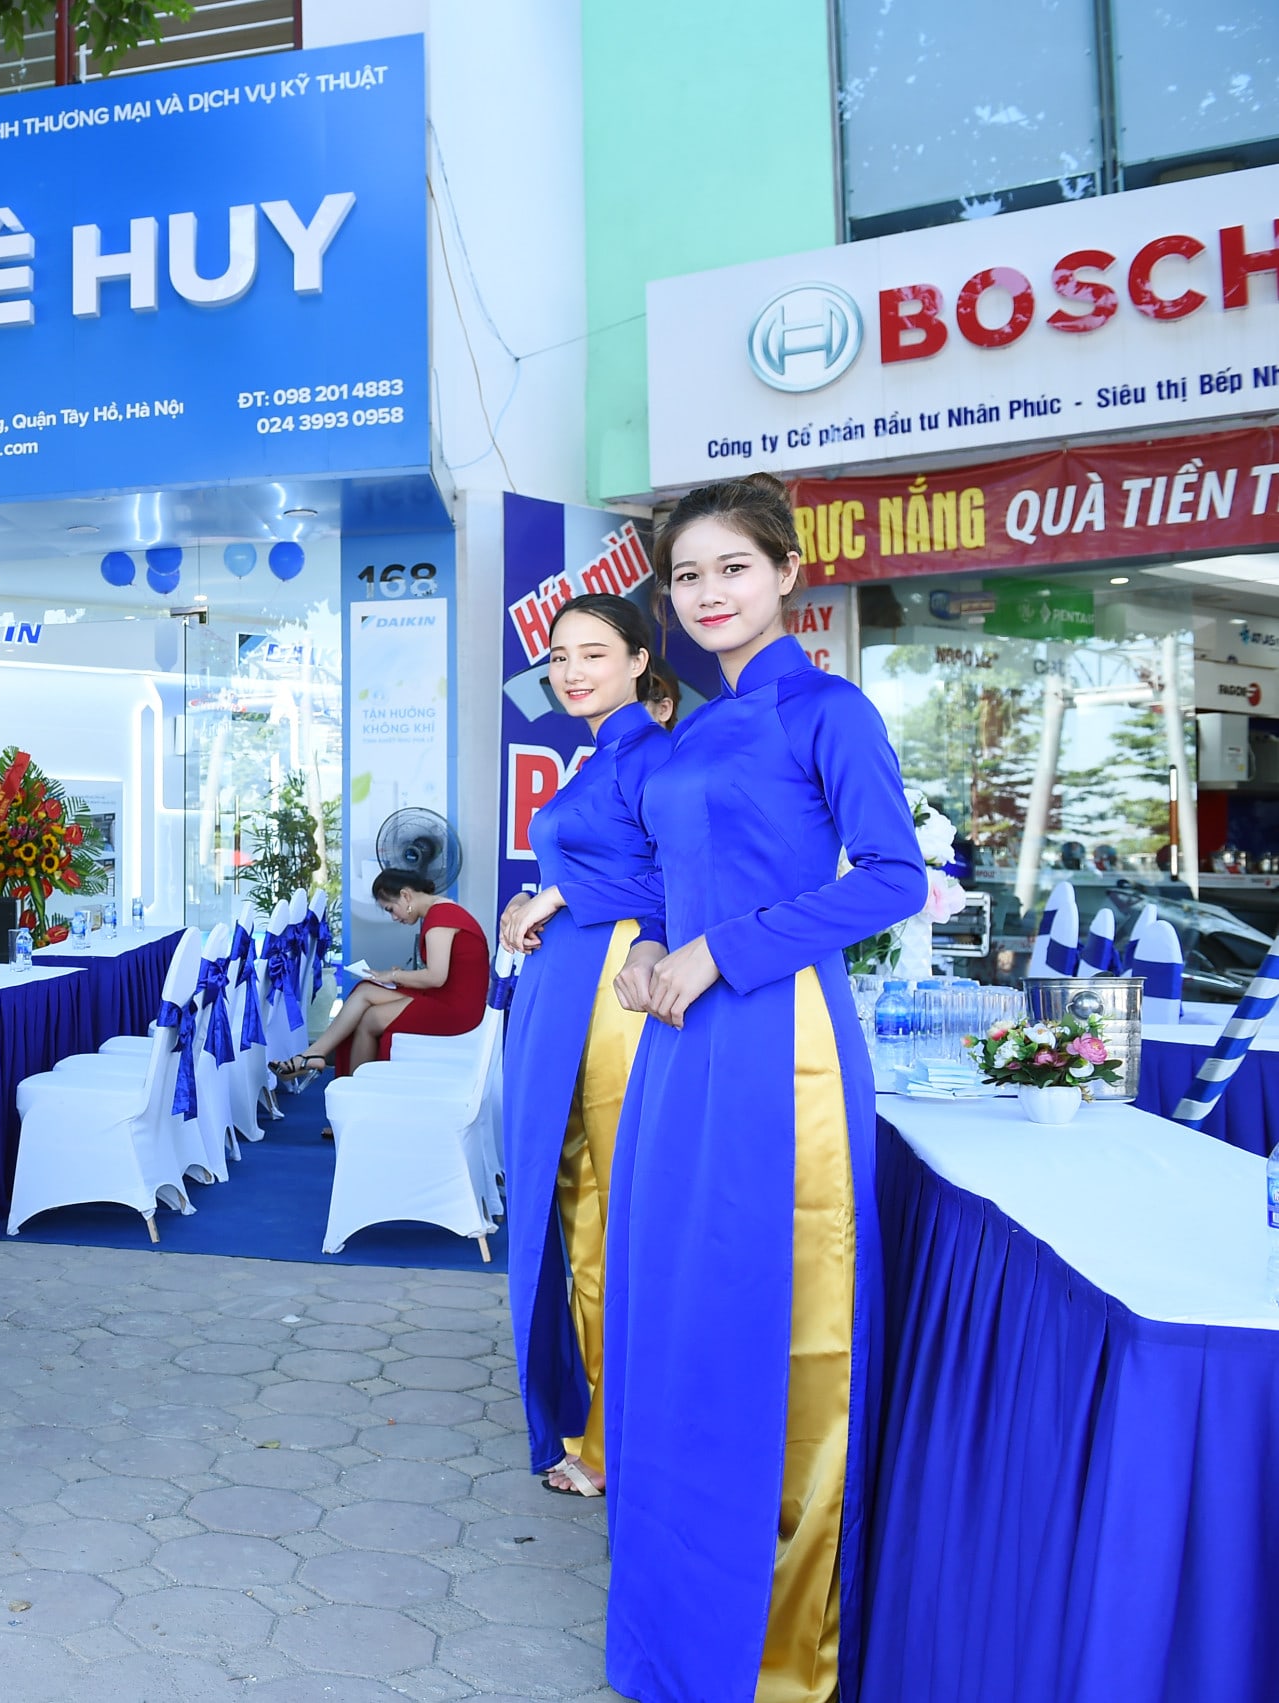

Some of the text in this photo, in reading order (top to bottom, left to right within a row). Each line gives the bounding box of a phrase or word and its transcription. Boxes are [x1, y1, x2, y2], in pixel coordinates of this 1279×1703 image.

[22, 107, 109, 135] THƯƠNG
[113, 101, 151, 122] MẠI
[156, 93, 184, 115] VÀ
[188, 87, 240, 113] DỊCH
[244, 82, 277, 104] VỤ
[280, 72, 310, 98] KỸ
[316, 65, 389, 91] THUẬT
[72, 192, 357, 318] HUY
[878, 217, 1279, 364] BOSCH
[12, 411, 57, 431] Quận
[60, 408, 90, 428] Tây
[94, 402, 124, 422] Hồ,
[125, 401, 151, 418] Hà
[154, 398, 185, 420] Nội
[237, 378, 404, 409] ĐT: 098 201 4883
[256, 406, 404, 434] 024 3993 0958
[707, 437, 753, 458] Công
[761, 433, 779, 453] ty
[787, 421, 814, 449] Cổ
[819, 416, 866, 447] phần
[873, 409, 913, 437] Đầu
[919, 411, 941, 432] tư
[947, 402, 1001, 428] Nhân
[1009, 394, 1062, 419] Phúc
[1097, 383, 1147, 408] Siêu
[1157, 377, 1188, 402] thị
[1200, 366, 1243, 395] Bếp
[879, 474, 986, 556] NẮNG
[1005, 472, 1106, 545] QUÀ
[1121, 457, 1238, 529] TIỀN
[1250, 463, 1279, 517] T
[358, 562, 438, 599] 168
[580, 525, 651, 597] mùi
[376, 615, 437, 628] DAIKIN
[362, 720, 436, 734] KHÔNG KHÍ
